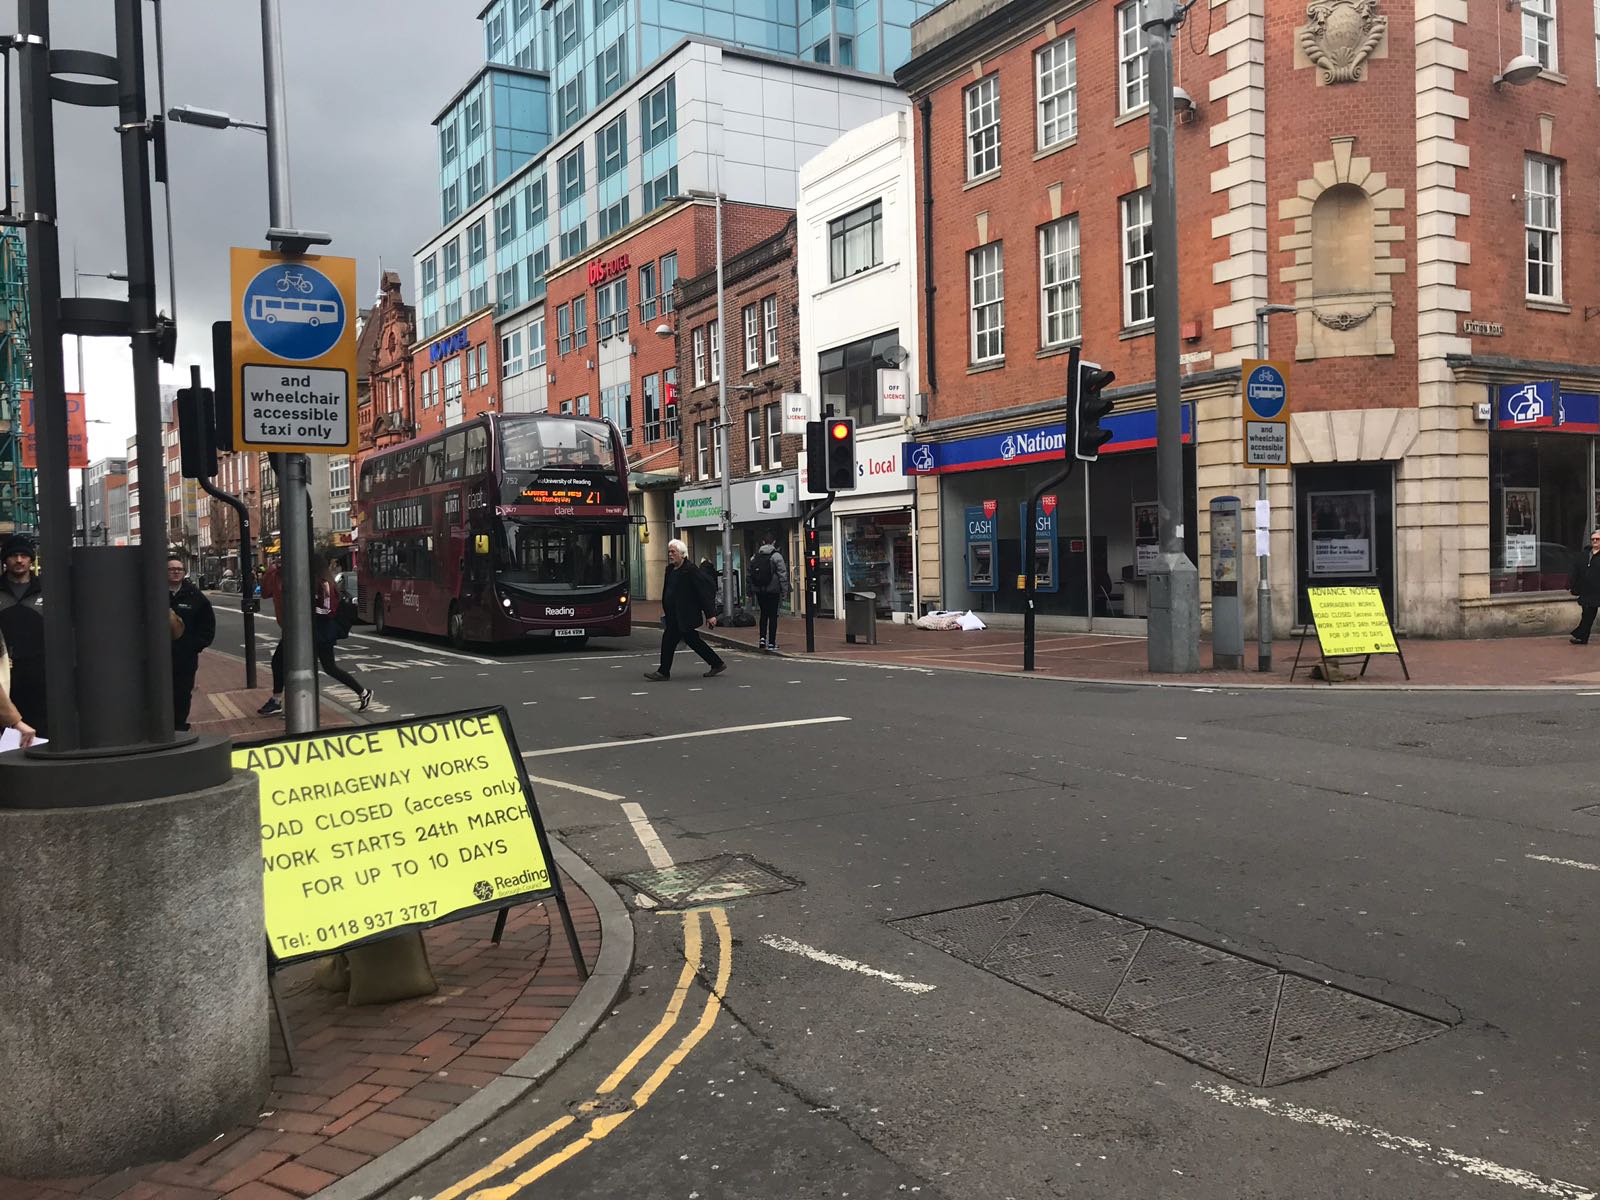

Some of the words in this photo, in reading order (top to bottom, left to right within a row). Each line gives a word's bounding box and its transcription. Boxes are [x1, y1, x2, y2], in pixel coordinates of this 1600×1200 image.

[1465, 322, 1488, 333] STATION
[281, 375, 311, 387] and
[250, 389, 340, 405] wheelchair
[253, 408, 338, 421] accessible
[260, 422, 291, 436] taxi
[297, 424, 332, 439] only
[1249, 434, 1284, 442] wheelchair
[1266, 453, 1281, 461] only
[869, 455, 896, 475] Local
[505, 477, 518, 485] 752
[543, 478, 567, 486] University
[572, 478, 591, 486] Reading
[686, 497, 712, 508] YORKSHIRE
[983, 502, 996, 510] FREE
[1042, 497, 1056, 505] FREE
[554, 506, 575, 515] claret
[968, 520, 992, 534] CASH
[1312, 588, 1347, 596] ADVANCE
[1349, 588, 1376, 596] NOTICE
[545, 606, 575, 617] Reading
[246, 732, 383, 770] ADVANCE
[397, 715, 494, 748] NOTICE
[272, 769, 411, 806] CARRIAGEWAY
[422, 756, 489, 779] WORKS
[260, 819, 303, 840] OAD
[315, 803, 393, 830] CLOSED
[405, 790, 473, 815] (access
[482, 776, 523, 797] only)
[331, 831, 406, 859] STARTS
[416, 821, 458, 842] 24th
[467, 804, 531, 830] MARCH
[302, 876, 344, 898] FOR
[355, 868, 381, 886] UP
[392, 860, 419, 878] TO
[428, 853, 449, 870] 10
[459, 839, 508, 863] DAYS
[494, 868, 549, 890] Reading
[277, 932, 311, 951] Tel:
[316, 919, 359, 942] 0118
[364, 911, 394, 930] 937
[399, 900, 438, 922] 3787
